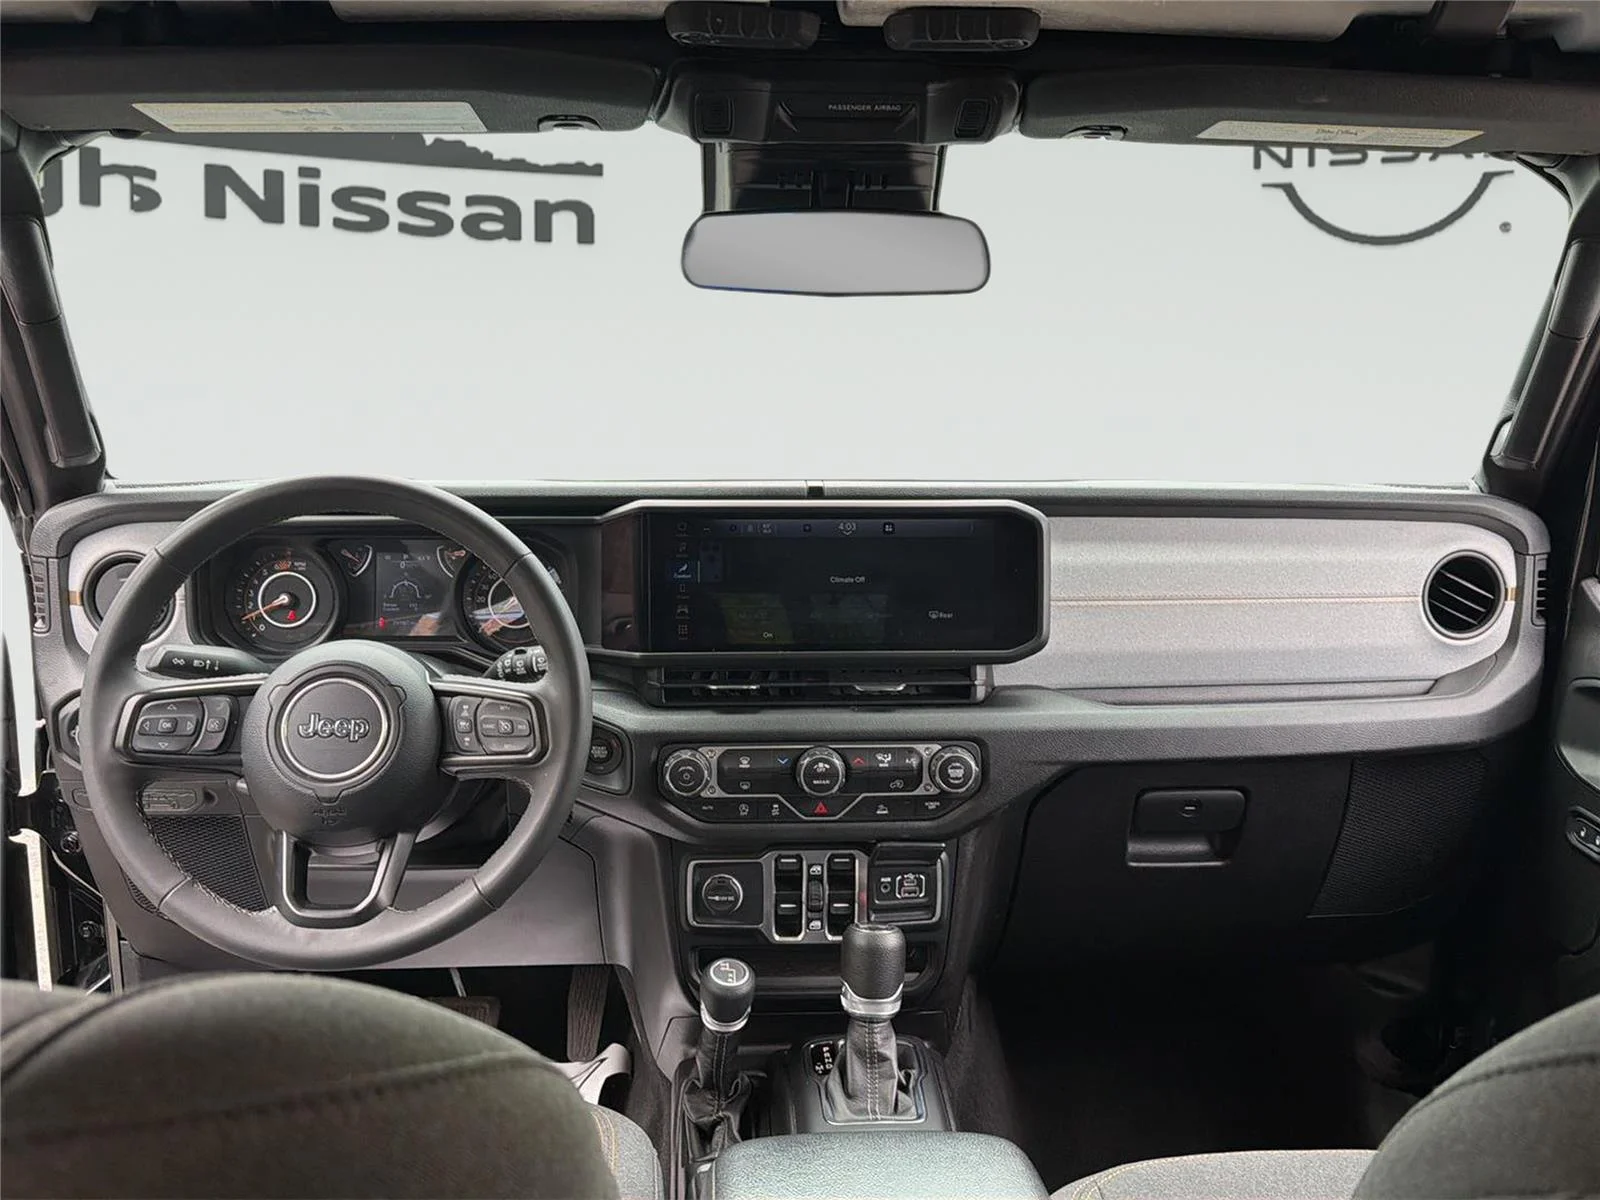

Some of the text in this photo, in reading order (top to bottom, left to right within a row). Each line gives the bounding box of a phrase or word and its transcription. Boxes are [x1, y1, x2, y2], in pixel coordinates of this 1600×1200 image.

[204, 163, 595, 244] Nissan
[830, 575, 866, 584] Climate Off
[762, 631, 774, 639] On
[297, 714, 370, 742] Jeep
